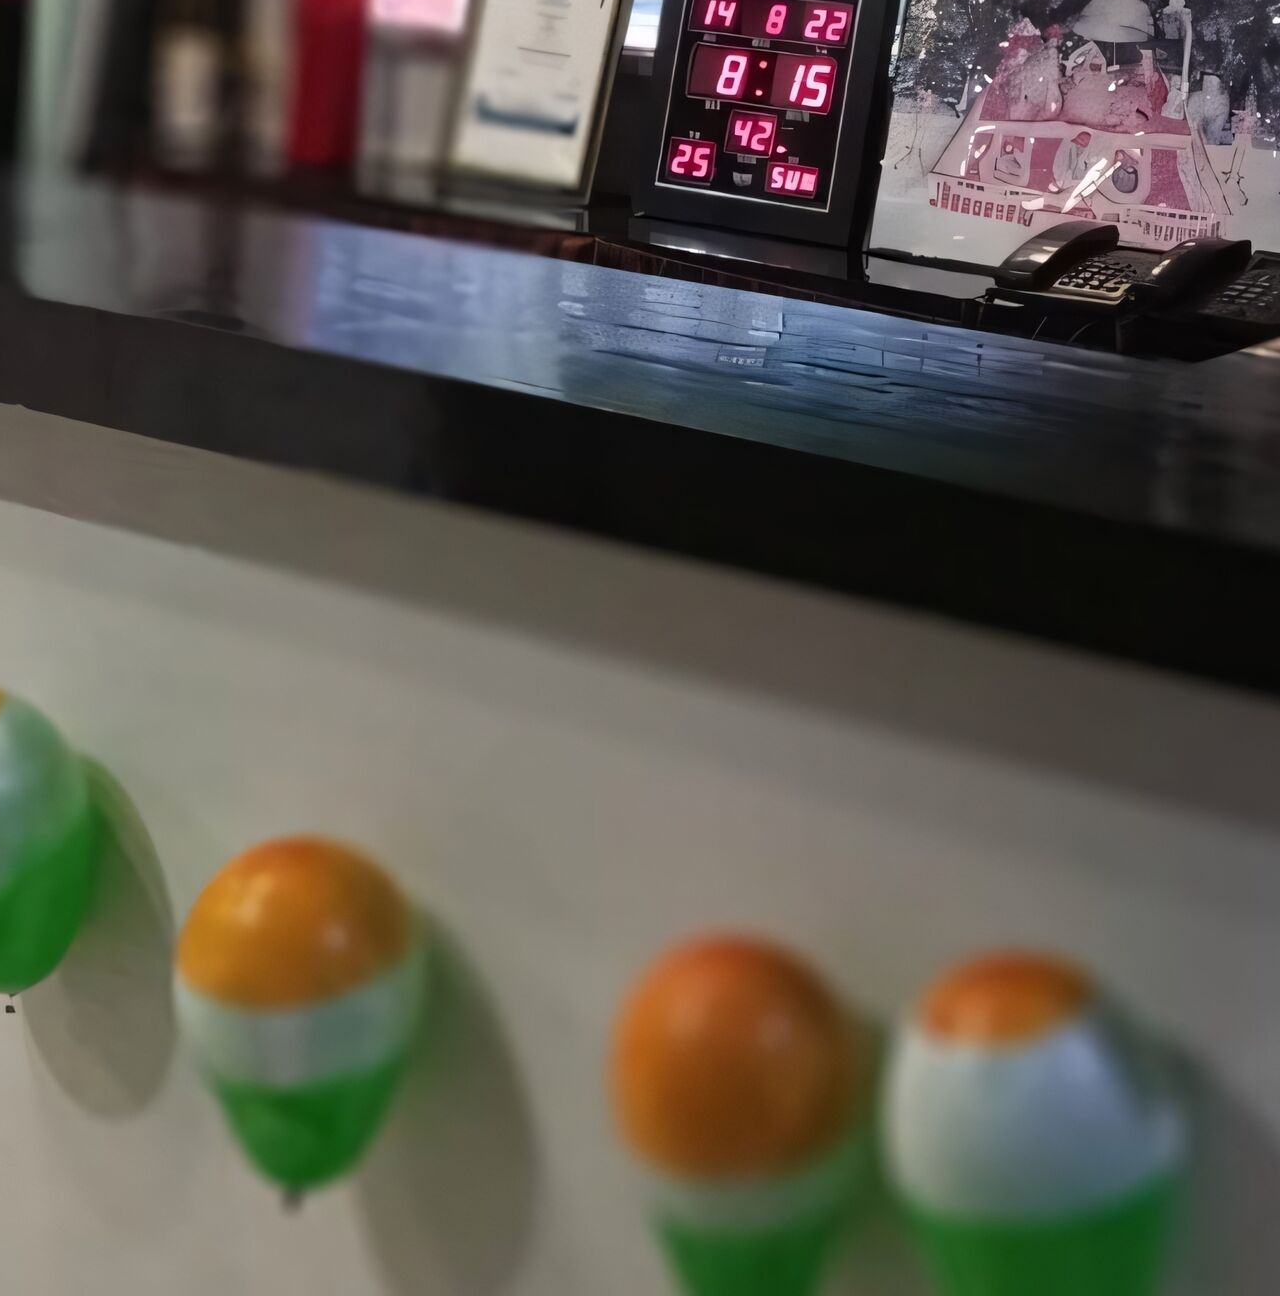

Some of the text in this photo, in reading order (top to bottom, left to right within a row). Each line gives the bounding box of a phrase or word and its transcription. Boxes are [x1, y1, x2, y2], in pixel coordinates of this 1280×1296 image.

[703, 0, 848, 41] 14 8 22
[733, 120, 773, 151] 42
[670, 143, 711, 178] 25
